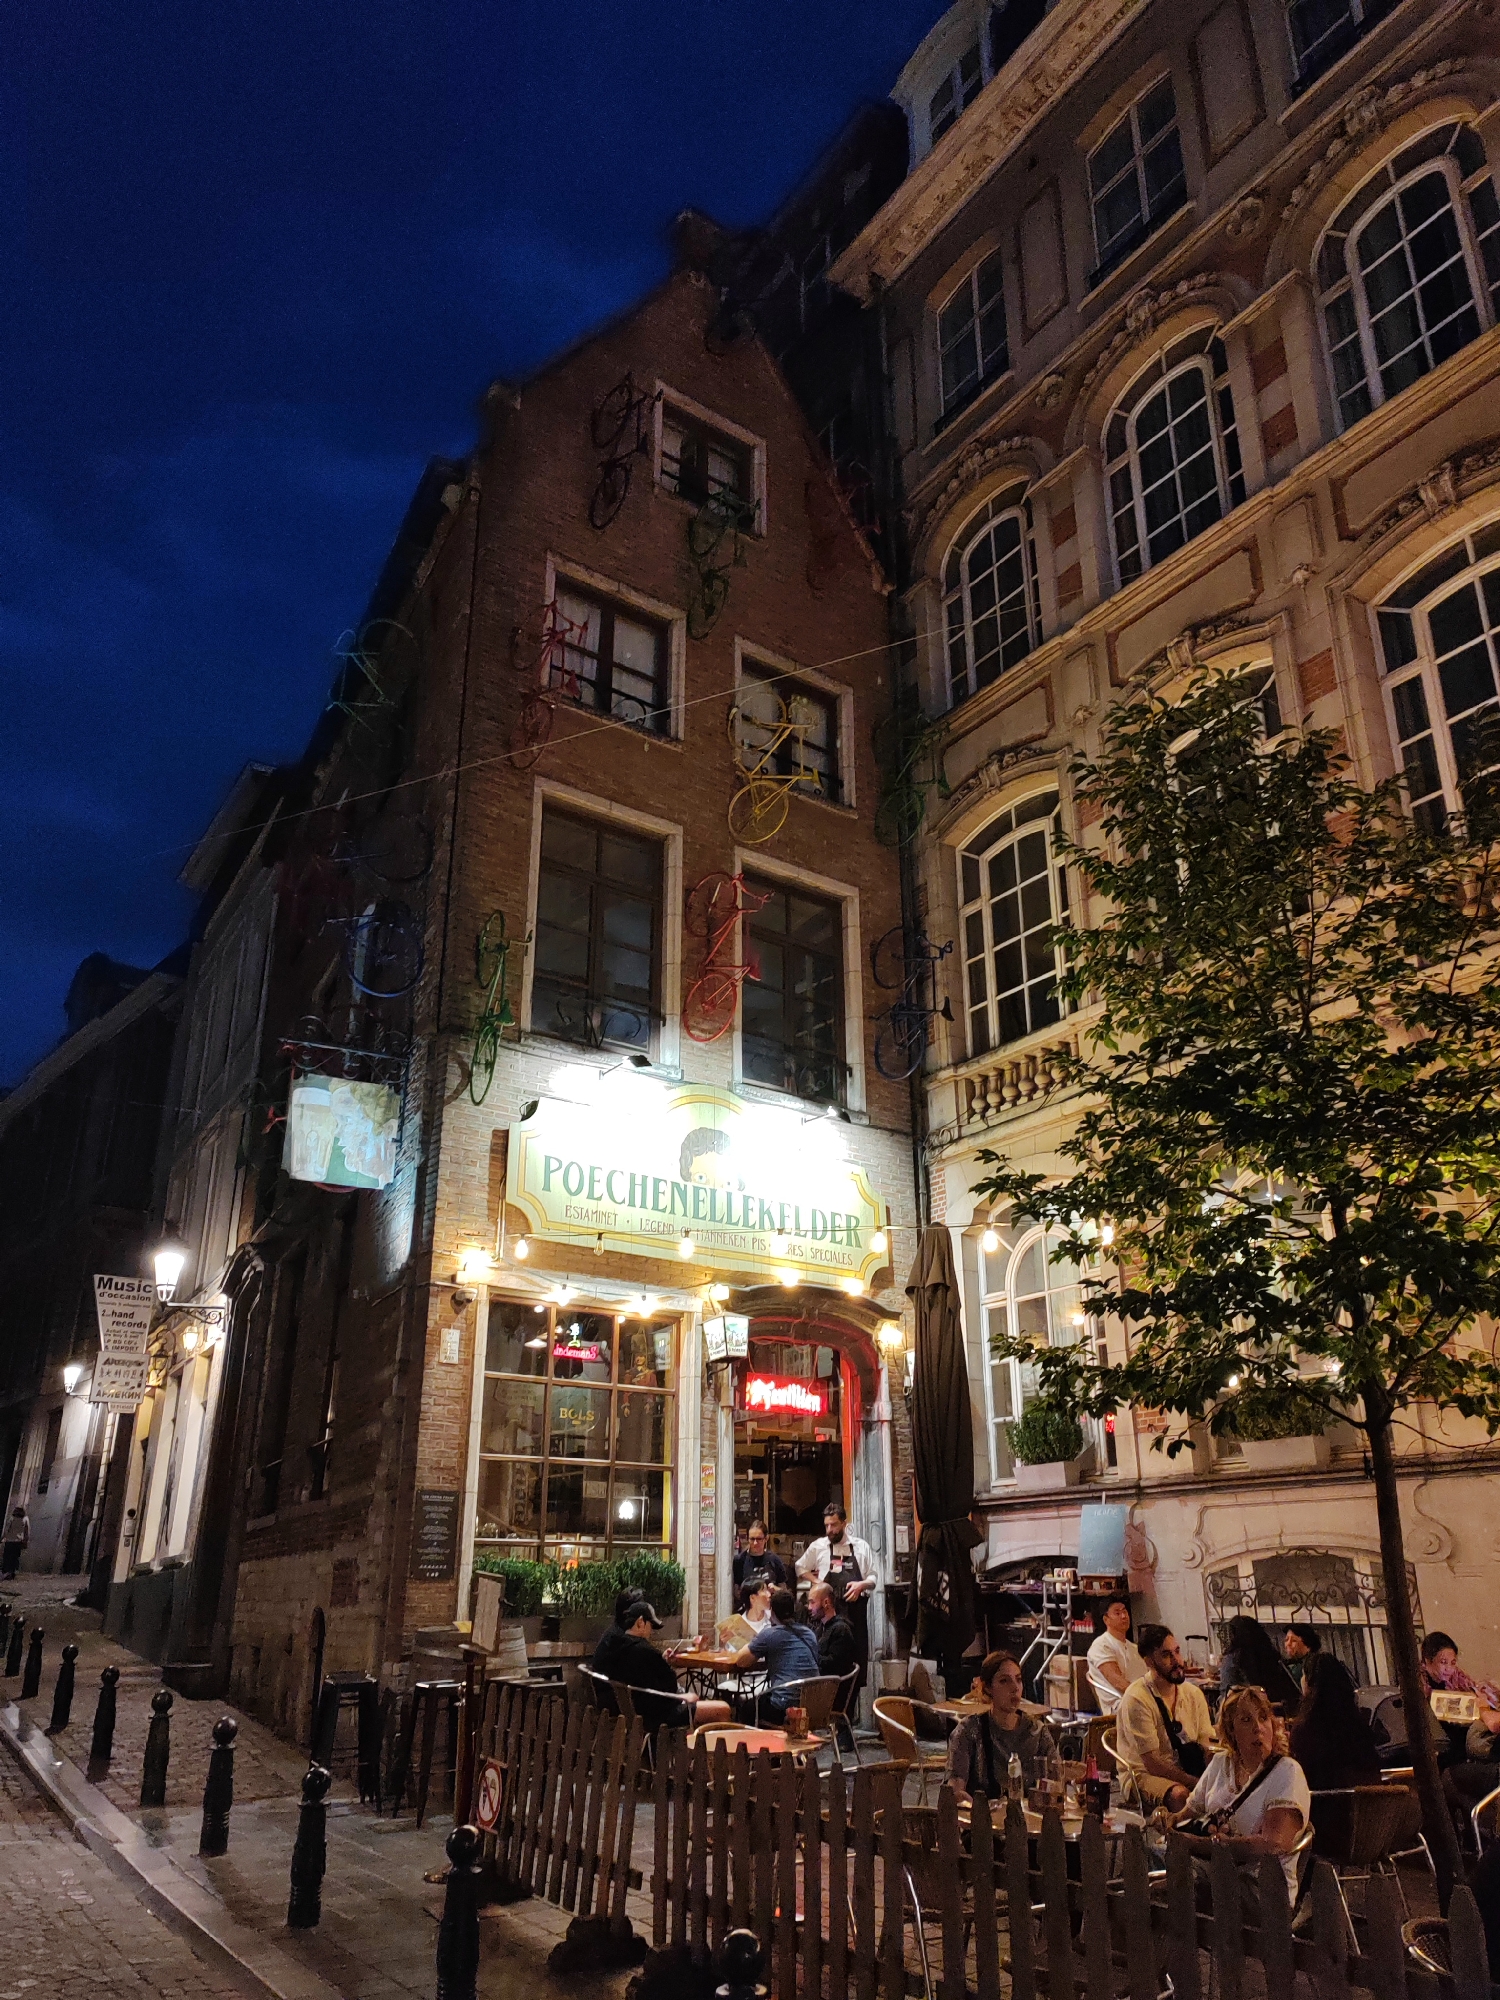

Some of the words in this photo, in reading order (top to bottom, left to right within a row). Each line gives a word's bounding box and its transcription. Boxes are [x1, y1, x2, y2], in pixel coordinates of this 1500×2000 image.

[541, 1154, 863, 1248] POECHENELLEKELDER
[564, 1205, 618, 1227] ESTAMINET
[640, 1217, 674, 1235] LEGEND
[751, 1236, 766, 1251] PIS
[810, 1246, 853, 1266] SPECIALES
[97, 1276, 153, 1293] Music
[99, 1291, 151, 1302] d'occasion
[111, 1309, 135, 1319] hand
[111, 1320, 148, 1330] records
